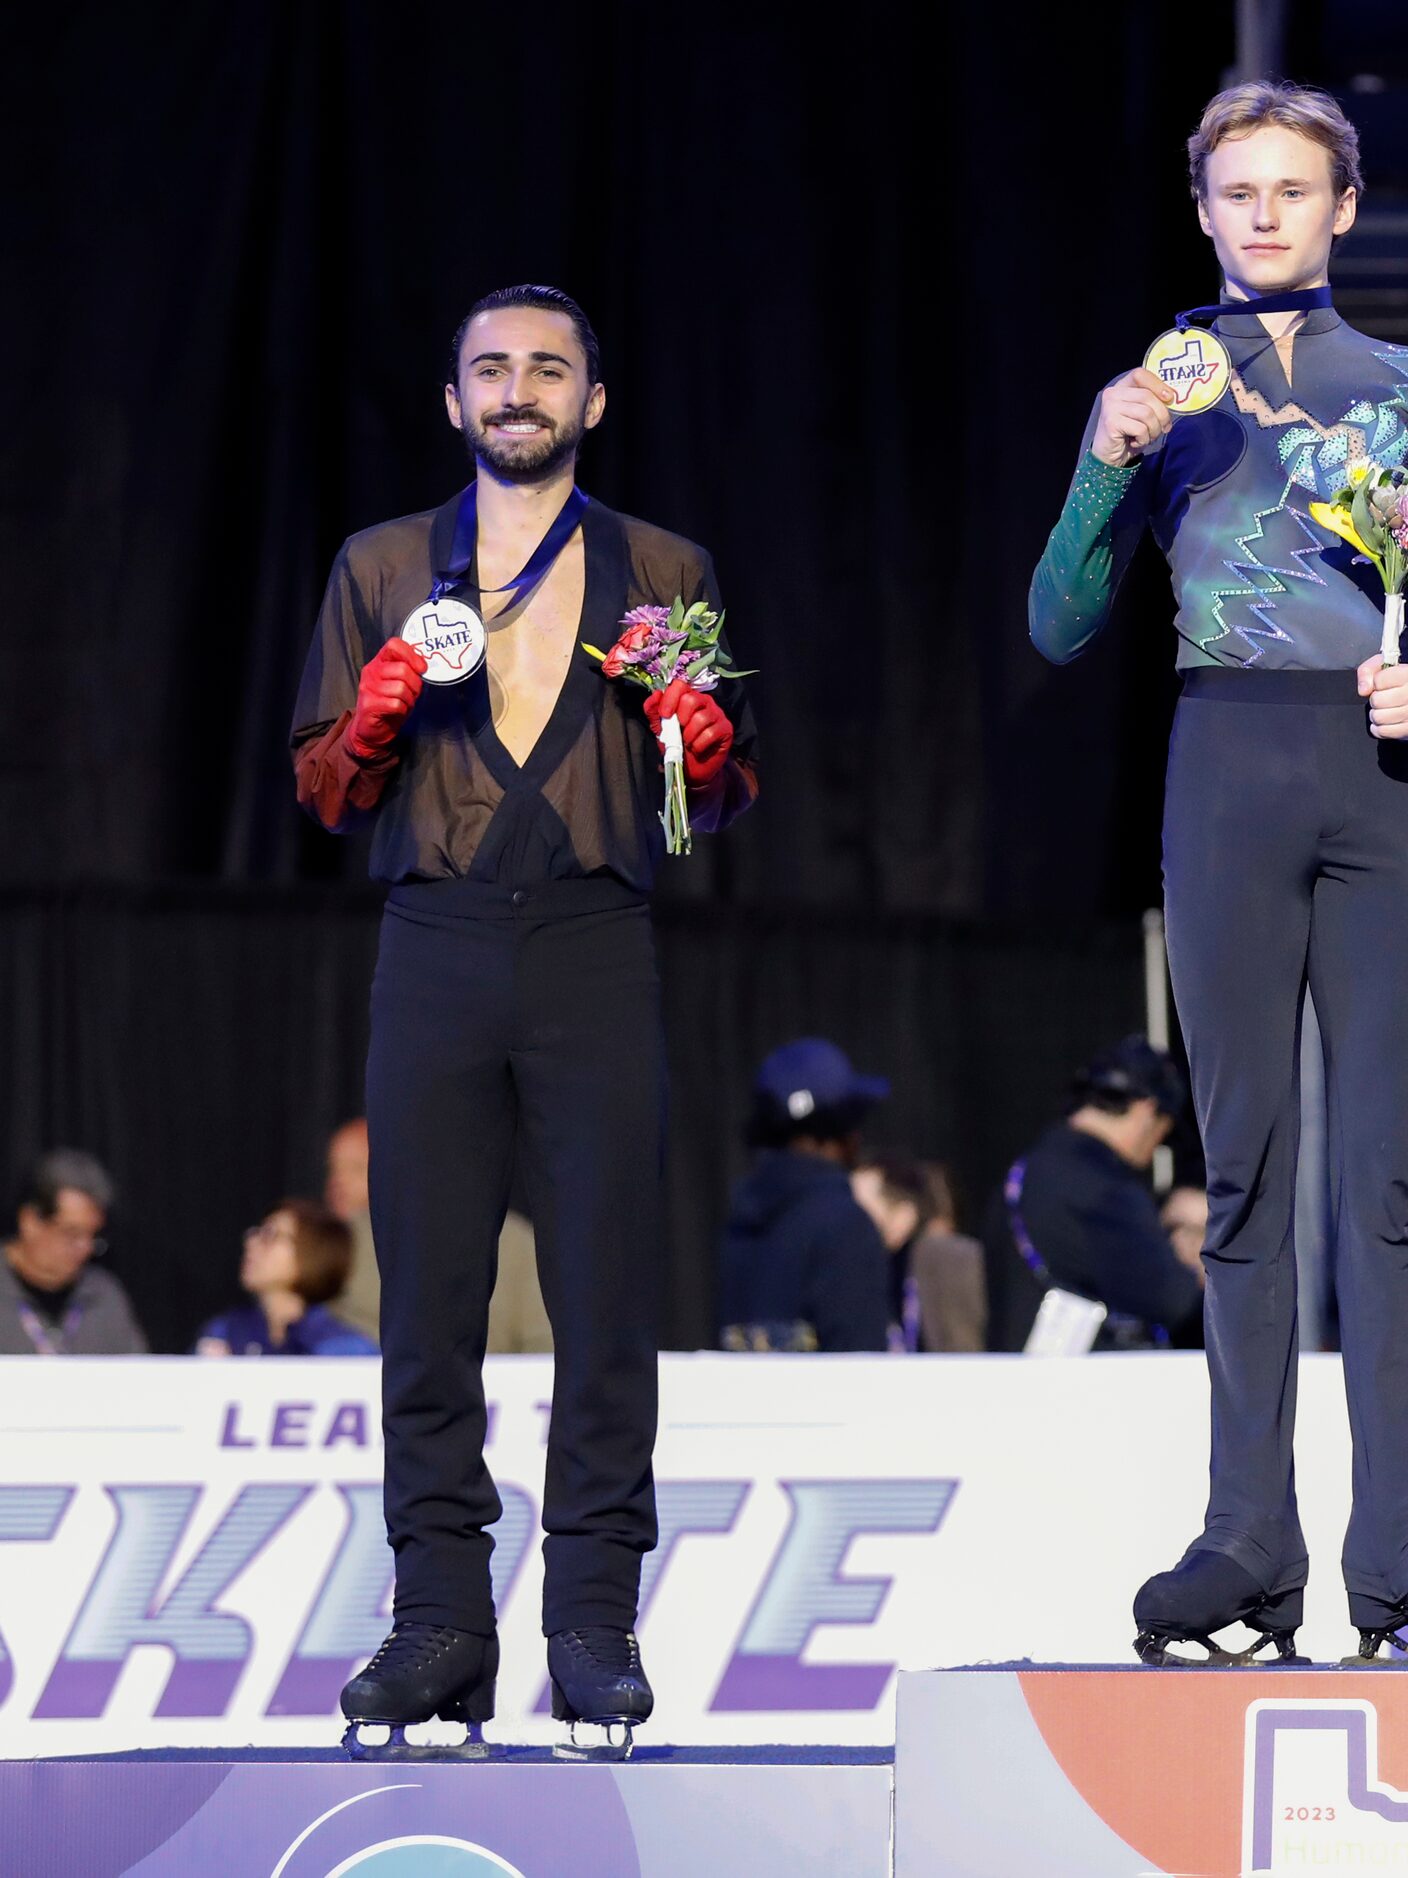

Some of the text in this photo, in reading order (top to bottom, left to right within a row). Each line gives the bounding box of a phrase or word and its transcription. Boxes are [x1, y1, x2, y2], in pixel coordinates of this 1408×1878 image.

[424, 629, 473, 652] SKATE
[220, 1401, 502, 1449] LEA
[1284, 1806, 1337, 1822] 2023
